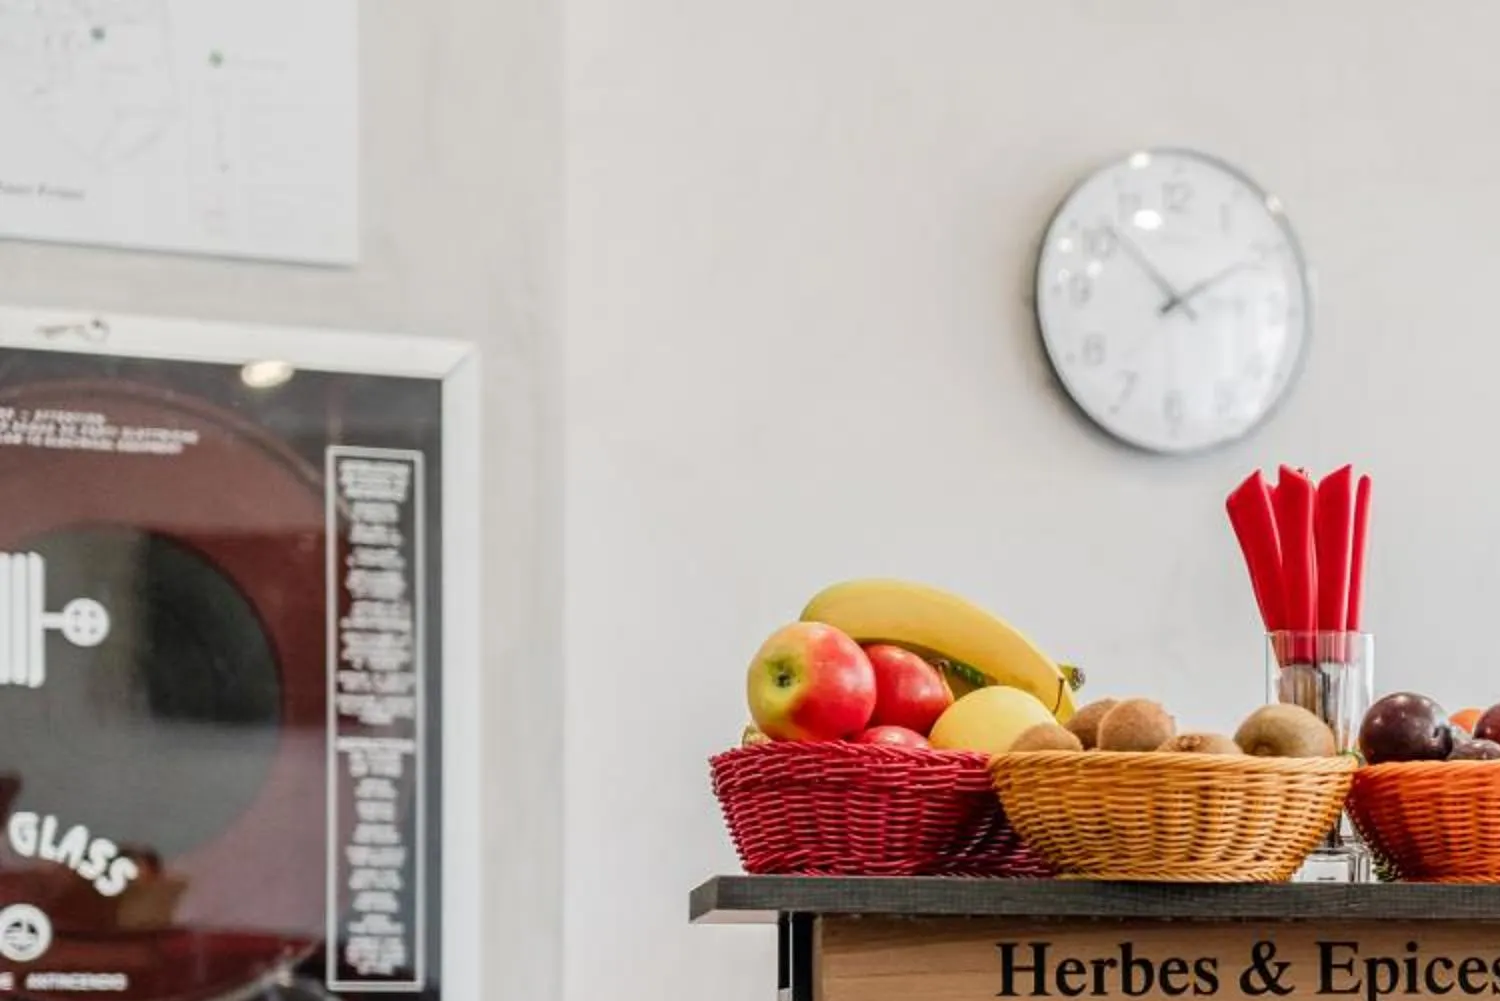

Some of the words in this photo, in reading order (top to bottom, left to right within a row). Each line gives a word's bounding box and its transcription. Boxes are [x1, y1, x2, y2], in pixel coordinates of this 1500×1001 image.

[1161, 181, 1194, 213] 12
[8, 811, 138, 897] GLASS
[995, 939, 1219, 996] Herbes
[1239, 940, 1296, 996] &
